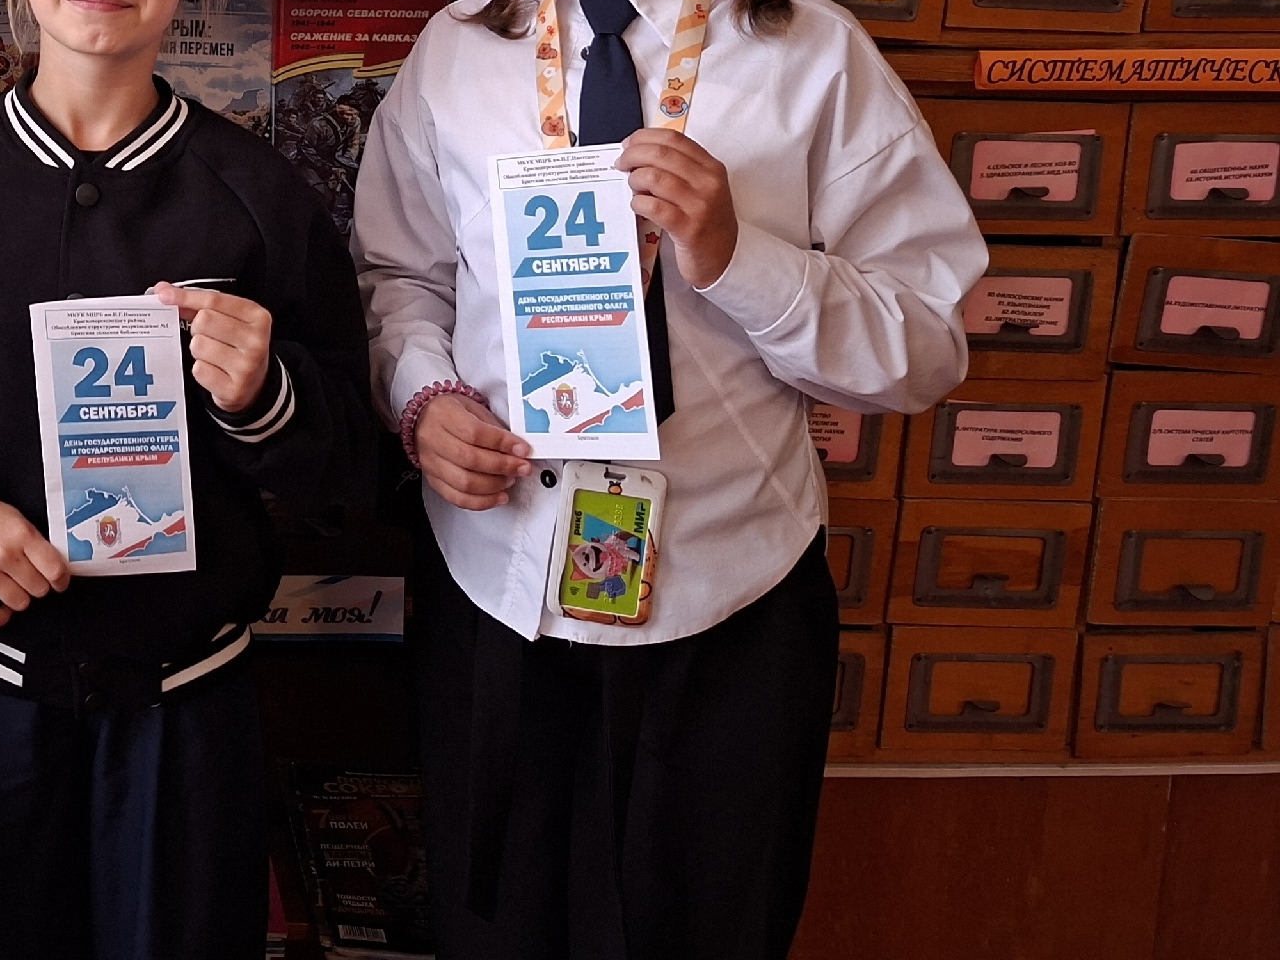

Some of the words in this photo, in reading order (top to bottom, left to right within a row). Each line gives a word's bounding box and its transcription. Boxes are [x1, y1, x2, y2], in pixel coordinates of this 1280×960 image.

[290, 9, 343, 18] ОБОРОНА
[347, 9, 429, 18] СЕВАСТОПОЛЯ
[168, 19, 212, 39] РЫМ:
[290, 32, 352, 42] СРАЖЕНИЕ
[354, 33, 370, 42] ЗА
[180, 42, 234, 56] ПЕРЕМЕН
[523, 191, 605, 251] 24
[532, 255, 610, 274] СЕНТЯБРЯ
[538, 293, 608, 303] ГОСУДАРСТВЕННОГО
[610, 292, 633, 300] ГЕРБА
[532, 304, 602, 313] ГОСУДАРСТВЕННОГО
[541, 316, 588, 324] РЕСПУБЛИКИ
[72, 346, 154, 398] 24
[79, 404, 157, 419] СЕНТЯБРЯ
[84, 437, 155, 446] ГОСУДАРСТВЕННОГО
[78, 446, 148, 454] ГОСУДАРСТВЕННОГО
[301, 590, 382, 624] моя!
